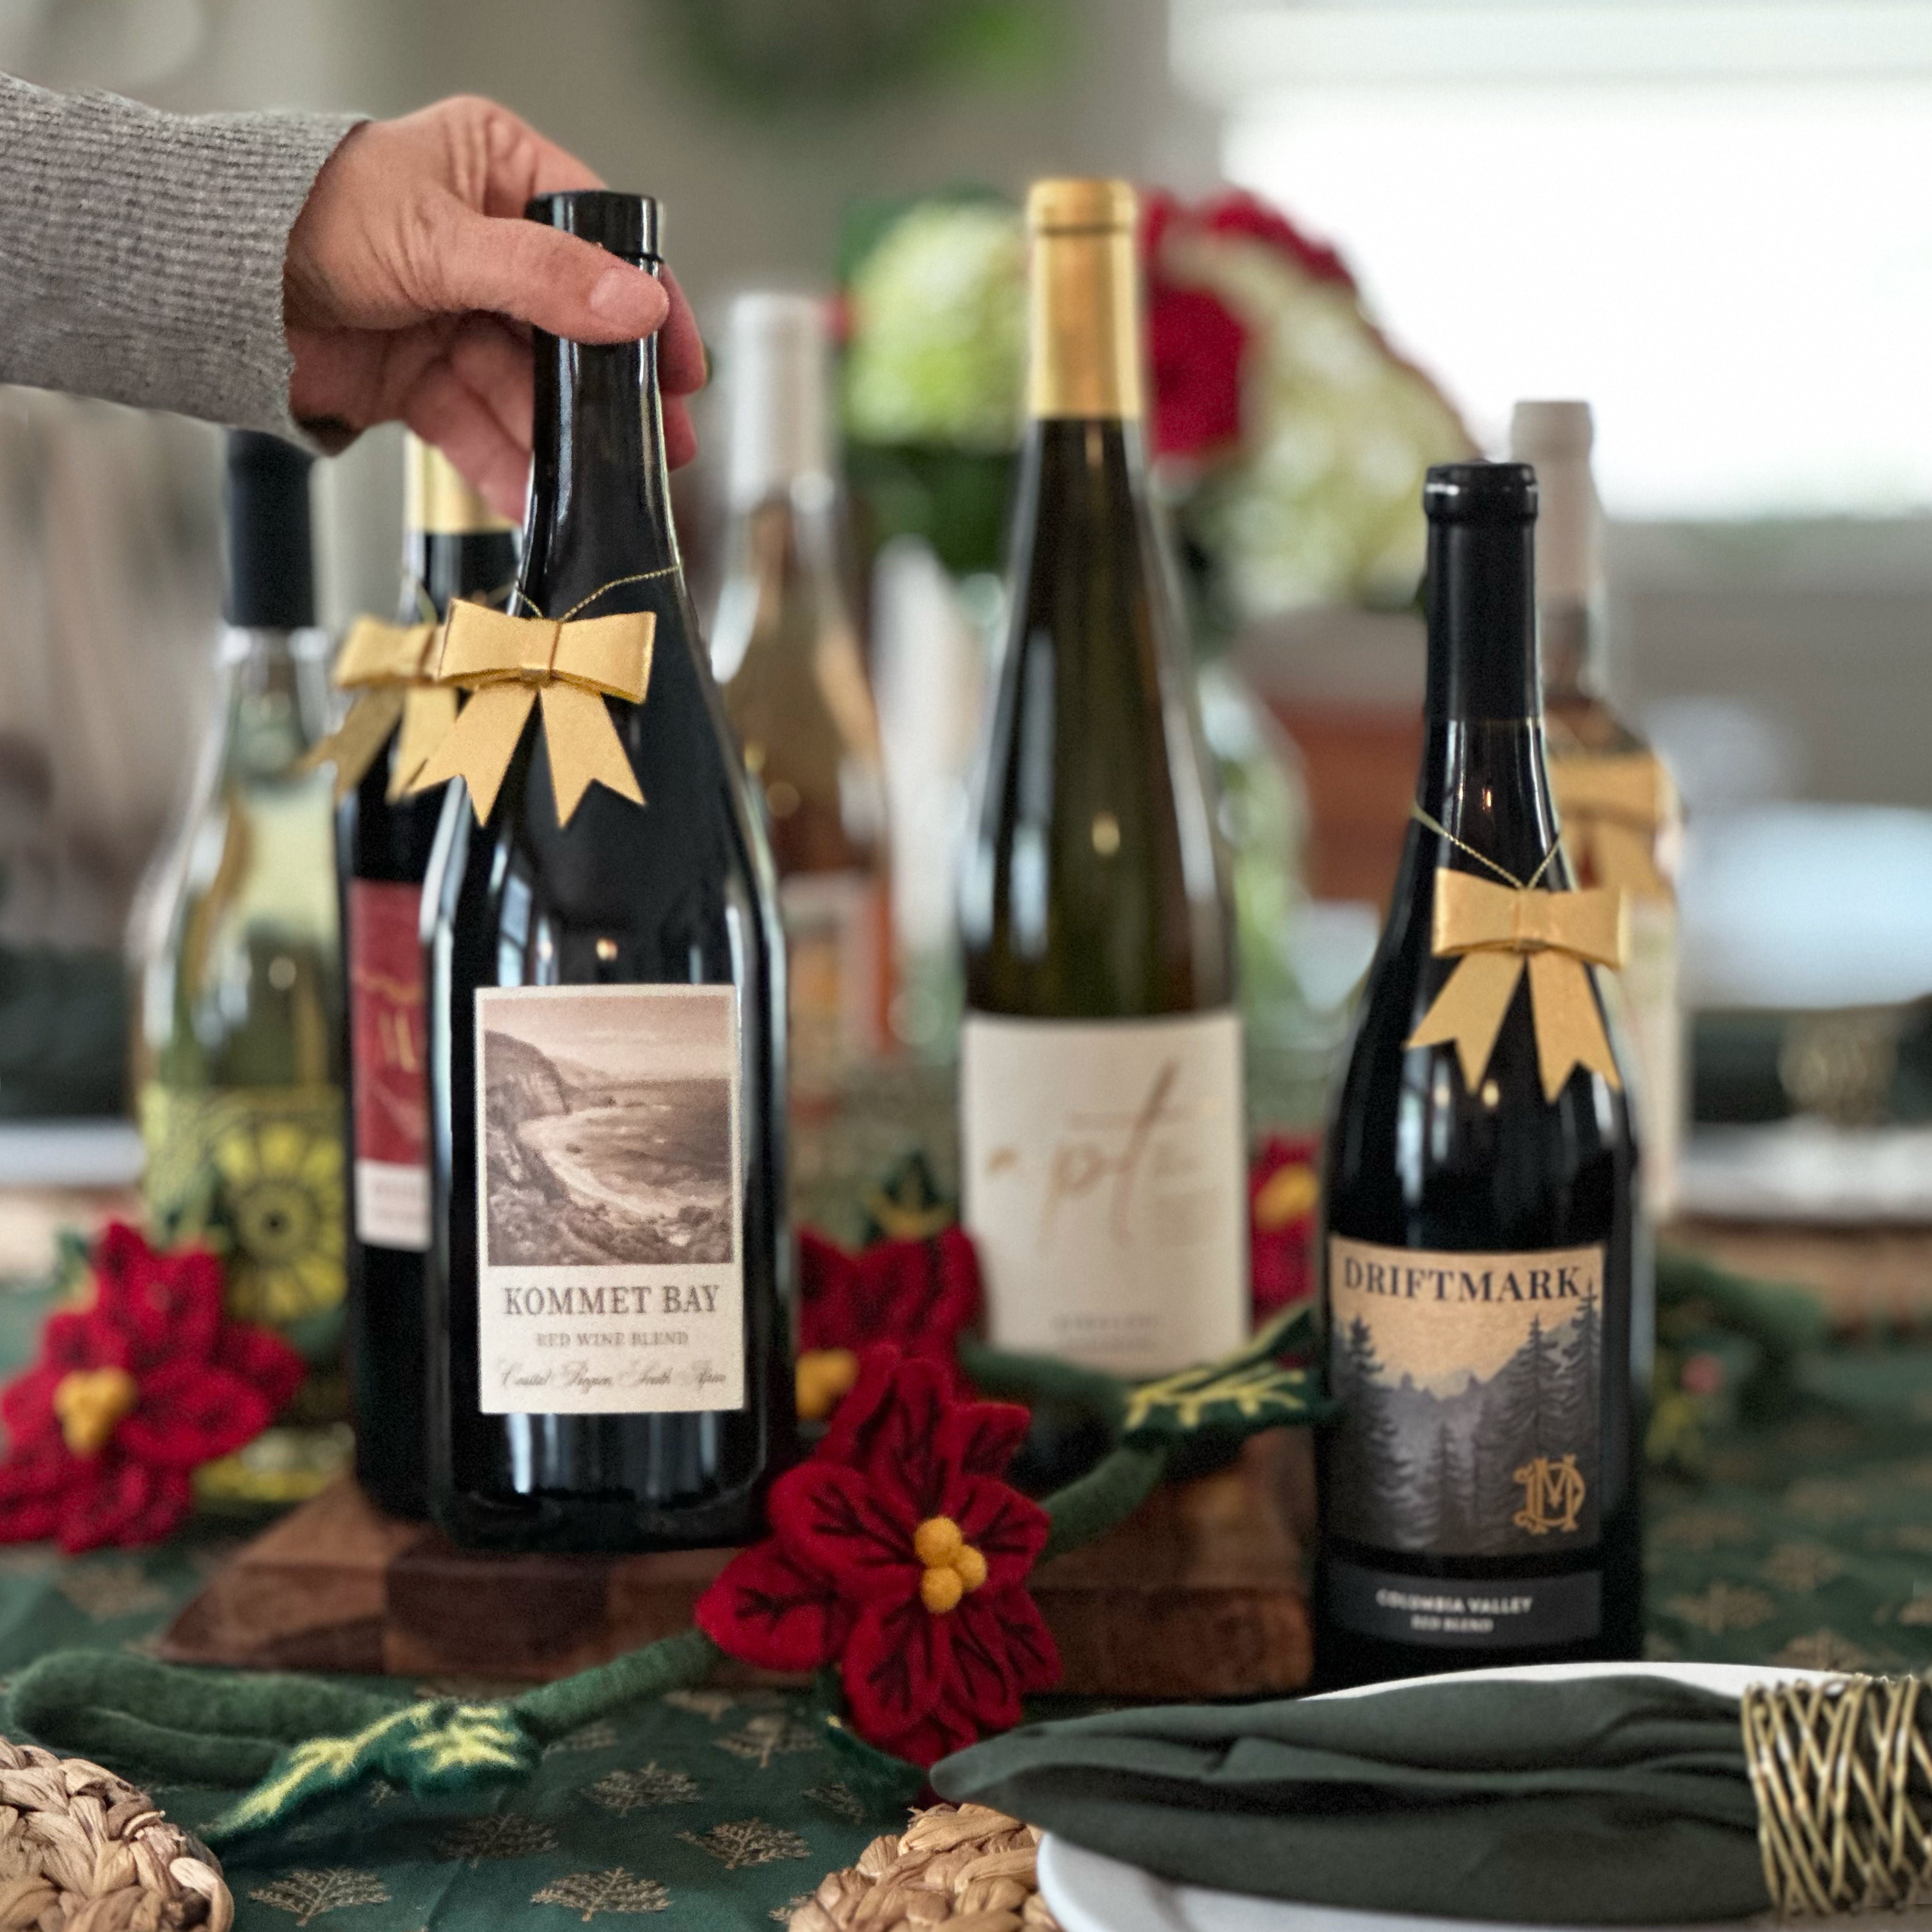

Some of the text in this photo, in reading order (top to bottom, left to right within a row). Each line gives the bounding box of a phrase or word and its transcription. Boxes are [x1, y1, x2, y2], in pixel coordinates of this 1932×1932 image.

[1344, 1256, 1581, 1302] DRIFTMARK
[502, 1284, 720, 1315] KOMMET BAY
[535, 1331, 689, 1347] RED WINE BLEND
[1375, 1587, 1534, 1615] COLUMBIA VALLEY
